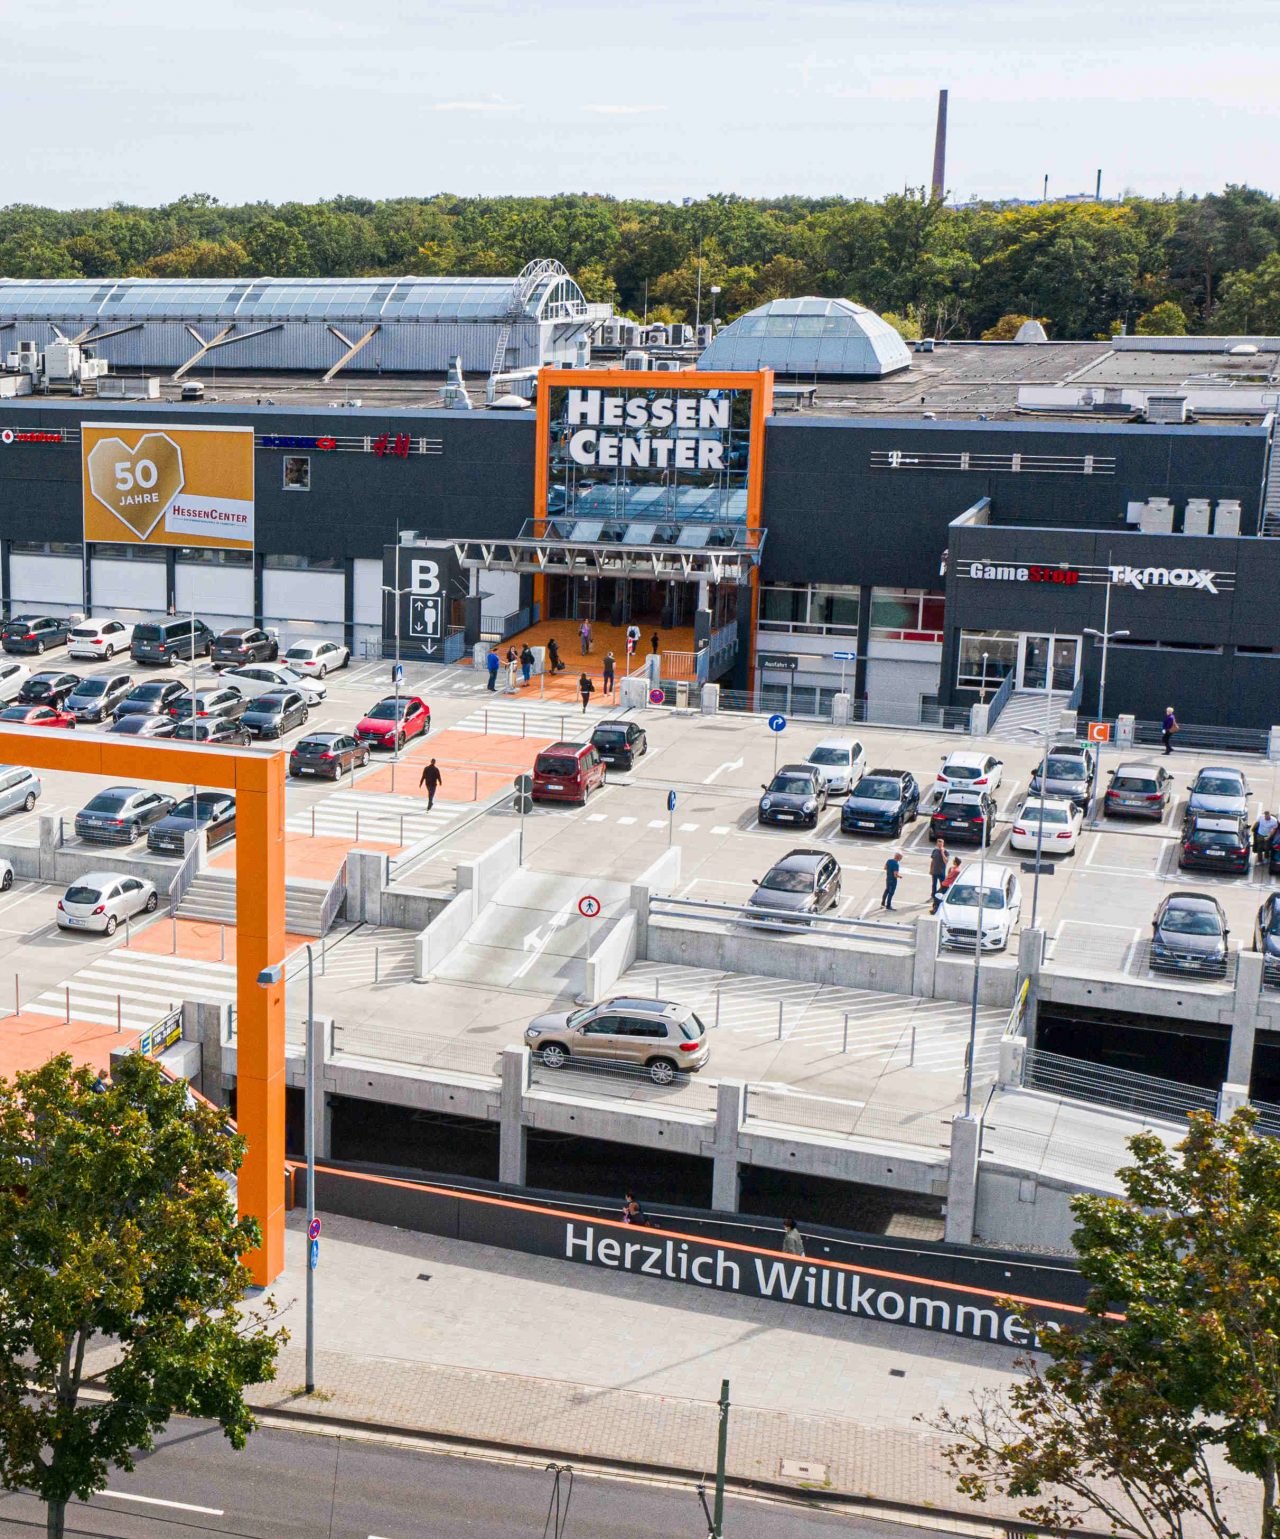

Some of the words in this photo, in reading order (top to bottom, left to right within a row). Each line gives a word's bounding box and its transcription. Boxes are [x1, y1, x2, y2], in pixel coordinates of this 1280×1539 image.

[568, 389, 729, 428] HESSEN
[570, 429, 725, 469] CENTER
[115, 459, 158, 490] 50
[120, 493, 159, 505] JAHRE
[411, 560, 439, 594] B
[970, 562, 1080, 585] GameStop
[1093, 726, 1104, 739] C
[565, 1223, 740, 1290] Herzlich
